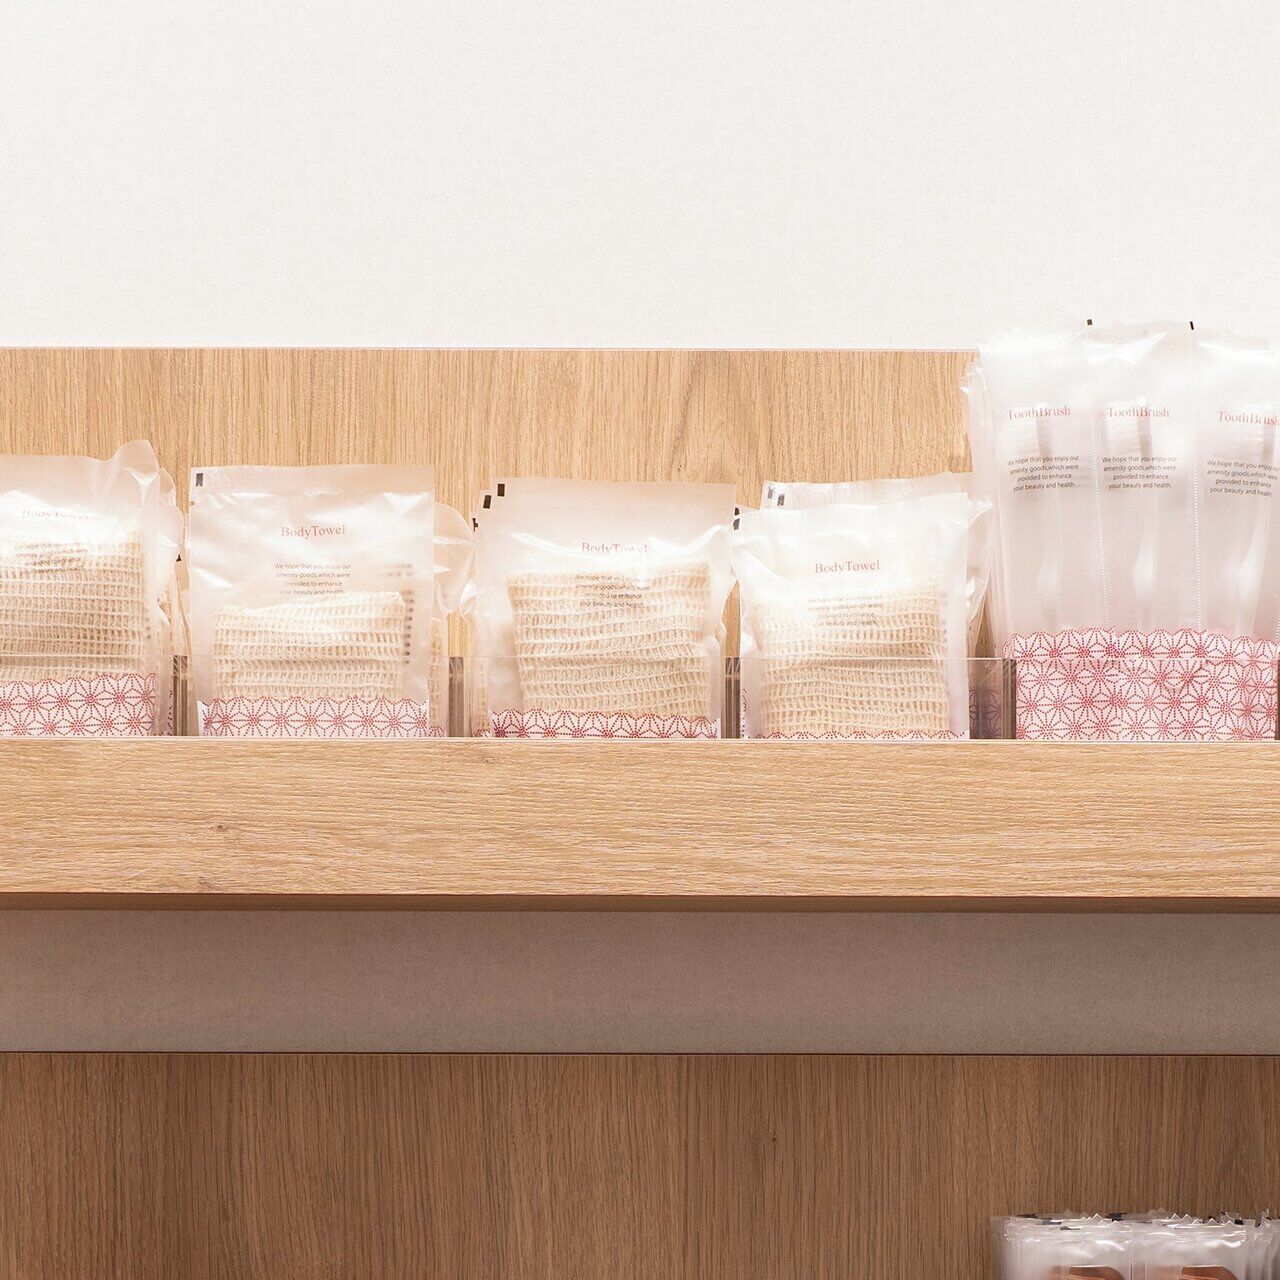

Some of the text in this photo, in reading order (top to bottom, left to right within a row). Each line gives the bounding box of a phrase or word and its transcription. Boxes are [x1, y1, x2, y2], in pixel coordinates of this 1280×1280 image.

[1008, 405, 1071, 420] ToothBrush
[1107, 406, 1170, 418] ToothBrush
[281, 525, 346, 540] BodyTowel
[815, 560, 880, 574] BodyTowel
